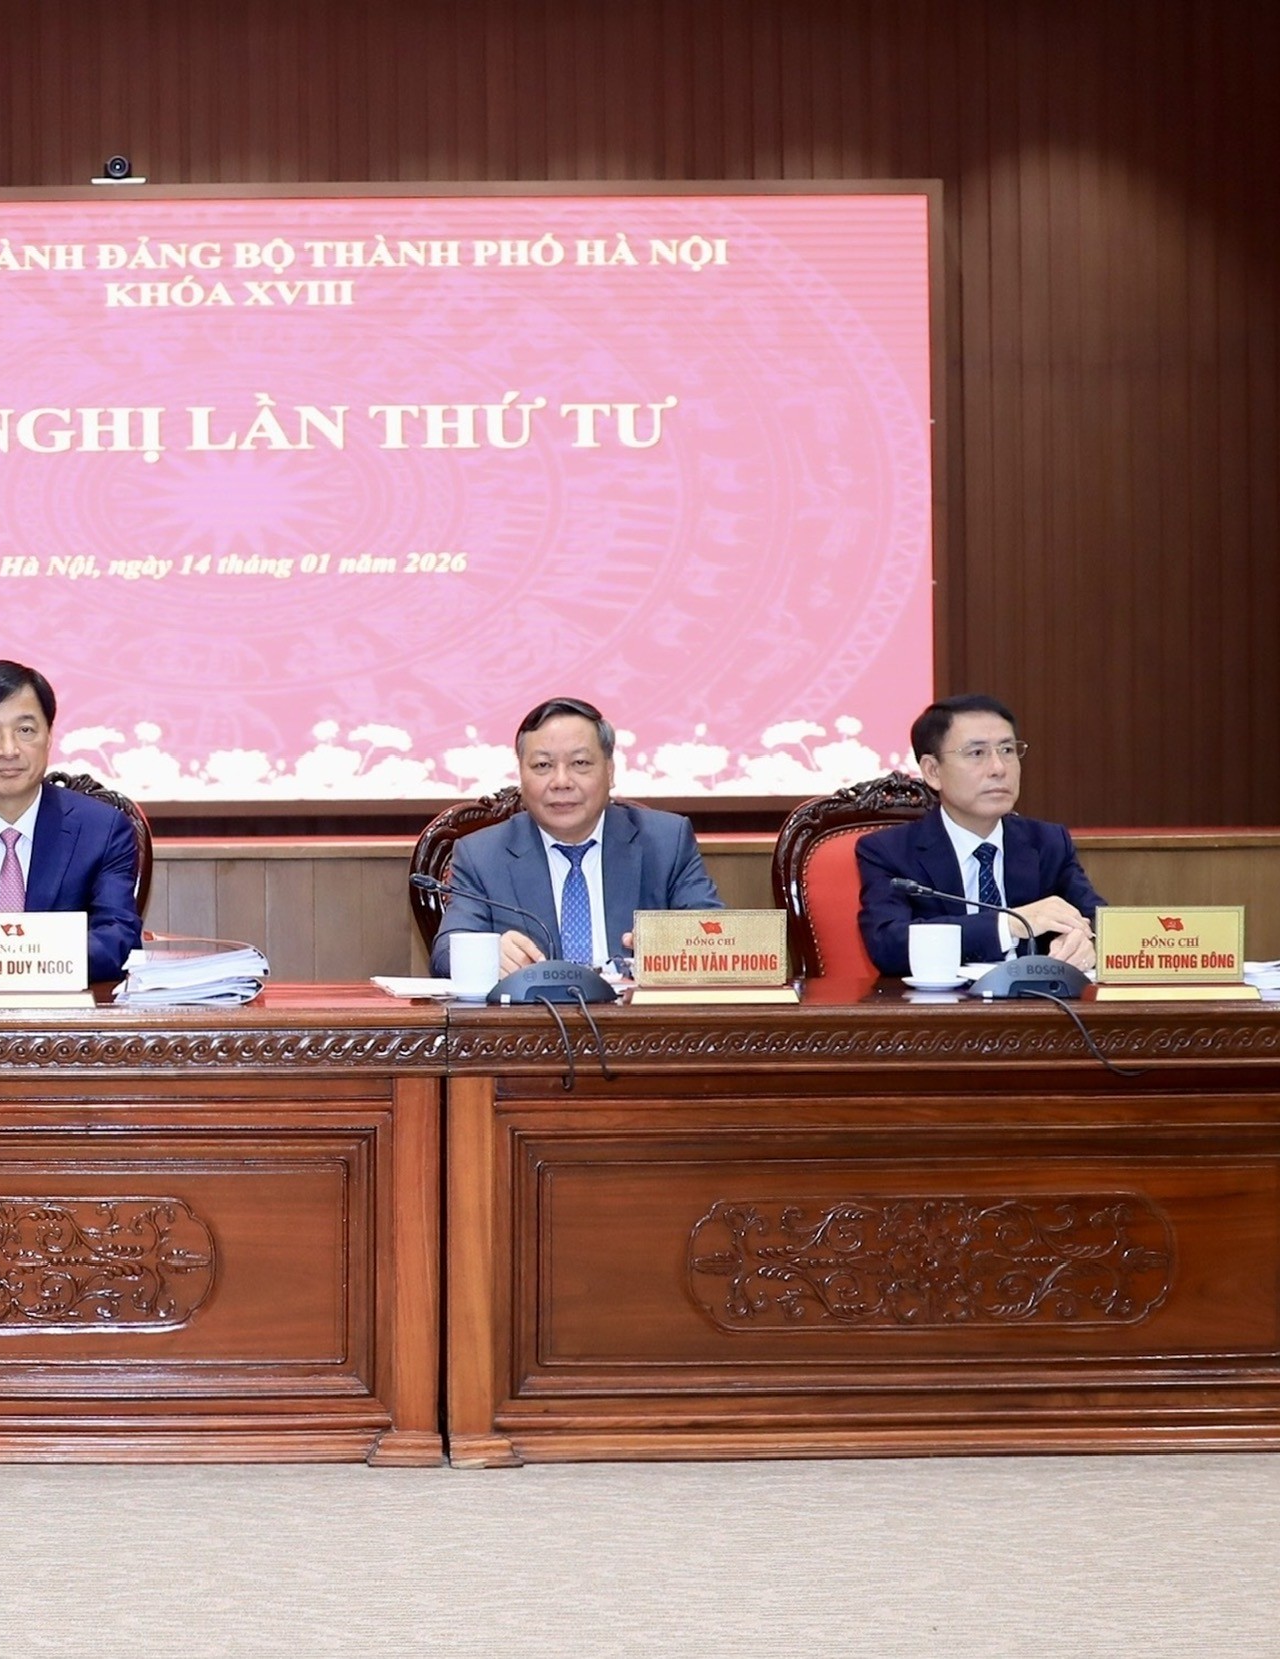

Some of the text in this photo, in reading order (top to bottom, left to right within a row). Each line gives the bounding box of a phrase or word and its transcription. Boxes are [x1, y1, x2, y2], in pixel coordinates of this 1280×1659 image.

[96, 235, 223, 270] ĐẢNG
[232, 237, 296, 275] BỘ
[303, 234, 462, 269] THÀNH
[472, 232, 565, 267] PHỐ
[574, 231, 639, 266] HÀ
[648, 234, 729, 272] NỘI
[104, 275, 356, 308] KHÓA XVIII
[185, 392, 351, 451] LẦN
[368, 390, 548, 450] THỨ
[560, 394, 678, 450] TƯ
[46, 554, 101, 581] Nội,
[108, 554, 174, 581] ngày
[179, 554, 212, 576] 14
[217, 553, 294, 579] tháng
[300, 553, 332, 574] 01
[338, 553, 398, 574] năm
[403, 552, 468, 574] 2026
[6, 959, 33, 976] DUY
[642, 948, 779, 972] NGUYỄN VĂN PHONG
[1026, 963, 1066, 976] BOSCH
[1105, 949, 1155, 970] NGUYỄN
[1157, 954, 1199, 973] TRỌNG
[542, 970, 583, 981] BOSCH
